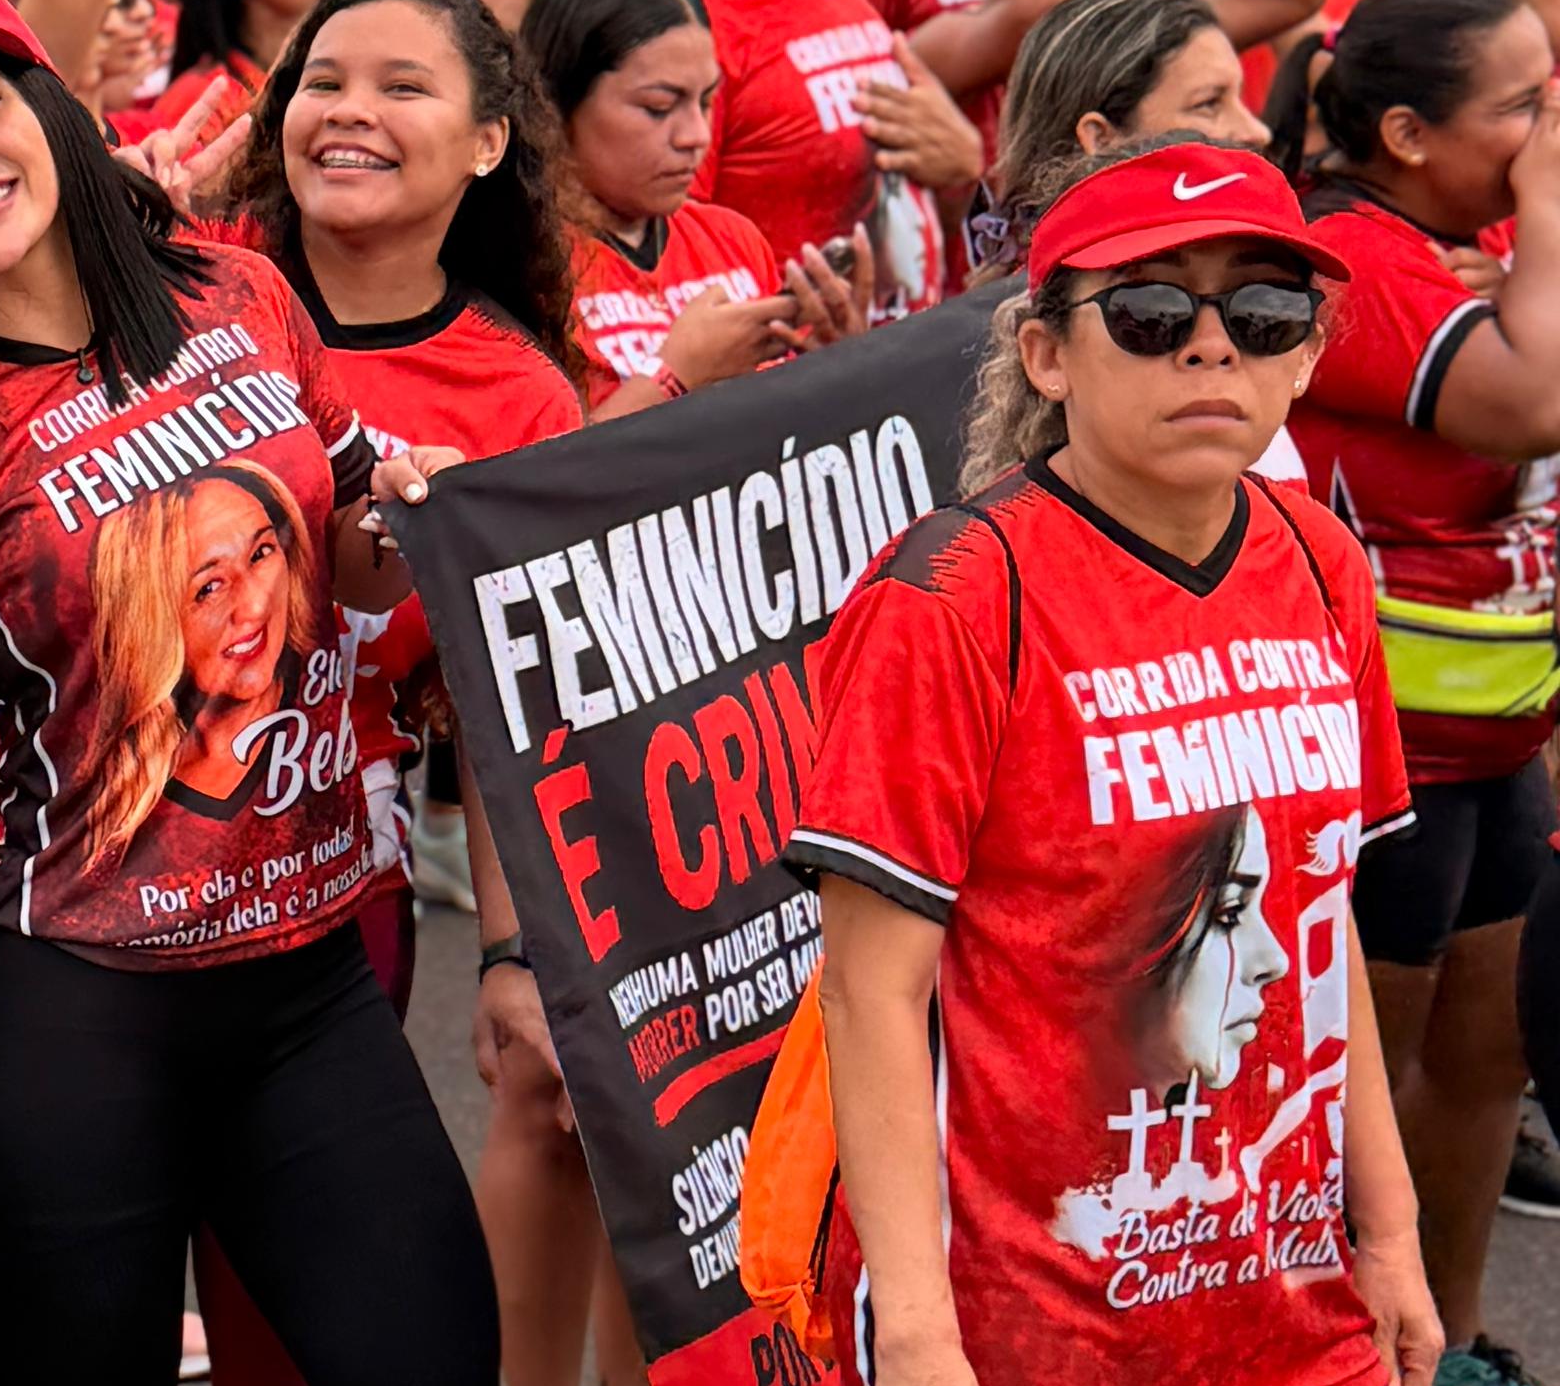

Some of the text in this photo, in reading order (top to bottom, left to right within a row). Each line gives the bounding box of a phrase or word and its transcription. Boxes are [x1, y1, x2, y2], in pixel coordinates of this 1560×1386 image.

[472, 414, 934, 754] FEMINICÍDIO
[1063, 645, 1230, 723] CORRIDA
[533, 724, 622, 963] É
[139, 884, 191, 918] Por
[201, 871, 236, 905] ela
[262, 851, 306, 890] por
[226, 895, 278, 935] dela
[285, 885, 300, 916] é
[306, 888, 318, 910] a
[608, 951, 699, 1029] NENHUMA
[702, 911, 779, 984] MULHER
[627, 1004, 701, 1083] MORRER
[704, 979, 760, 1040] POR
[756, 957, 793, 1015] SER
[1114, 1201, 1220, 1260] Basta
[1106, 1249, 1229, 1310] Contra
[1237, 1254, 1259, 1284] a
